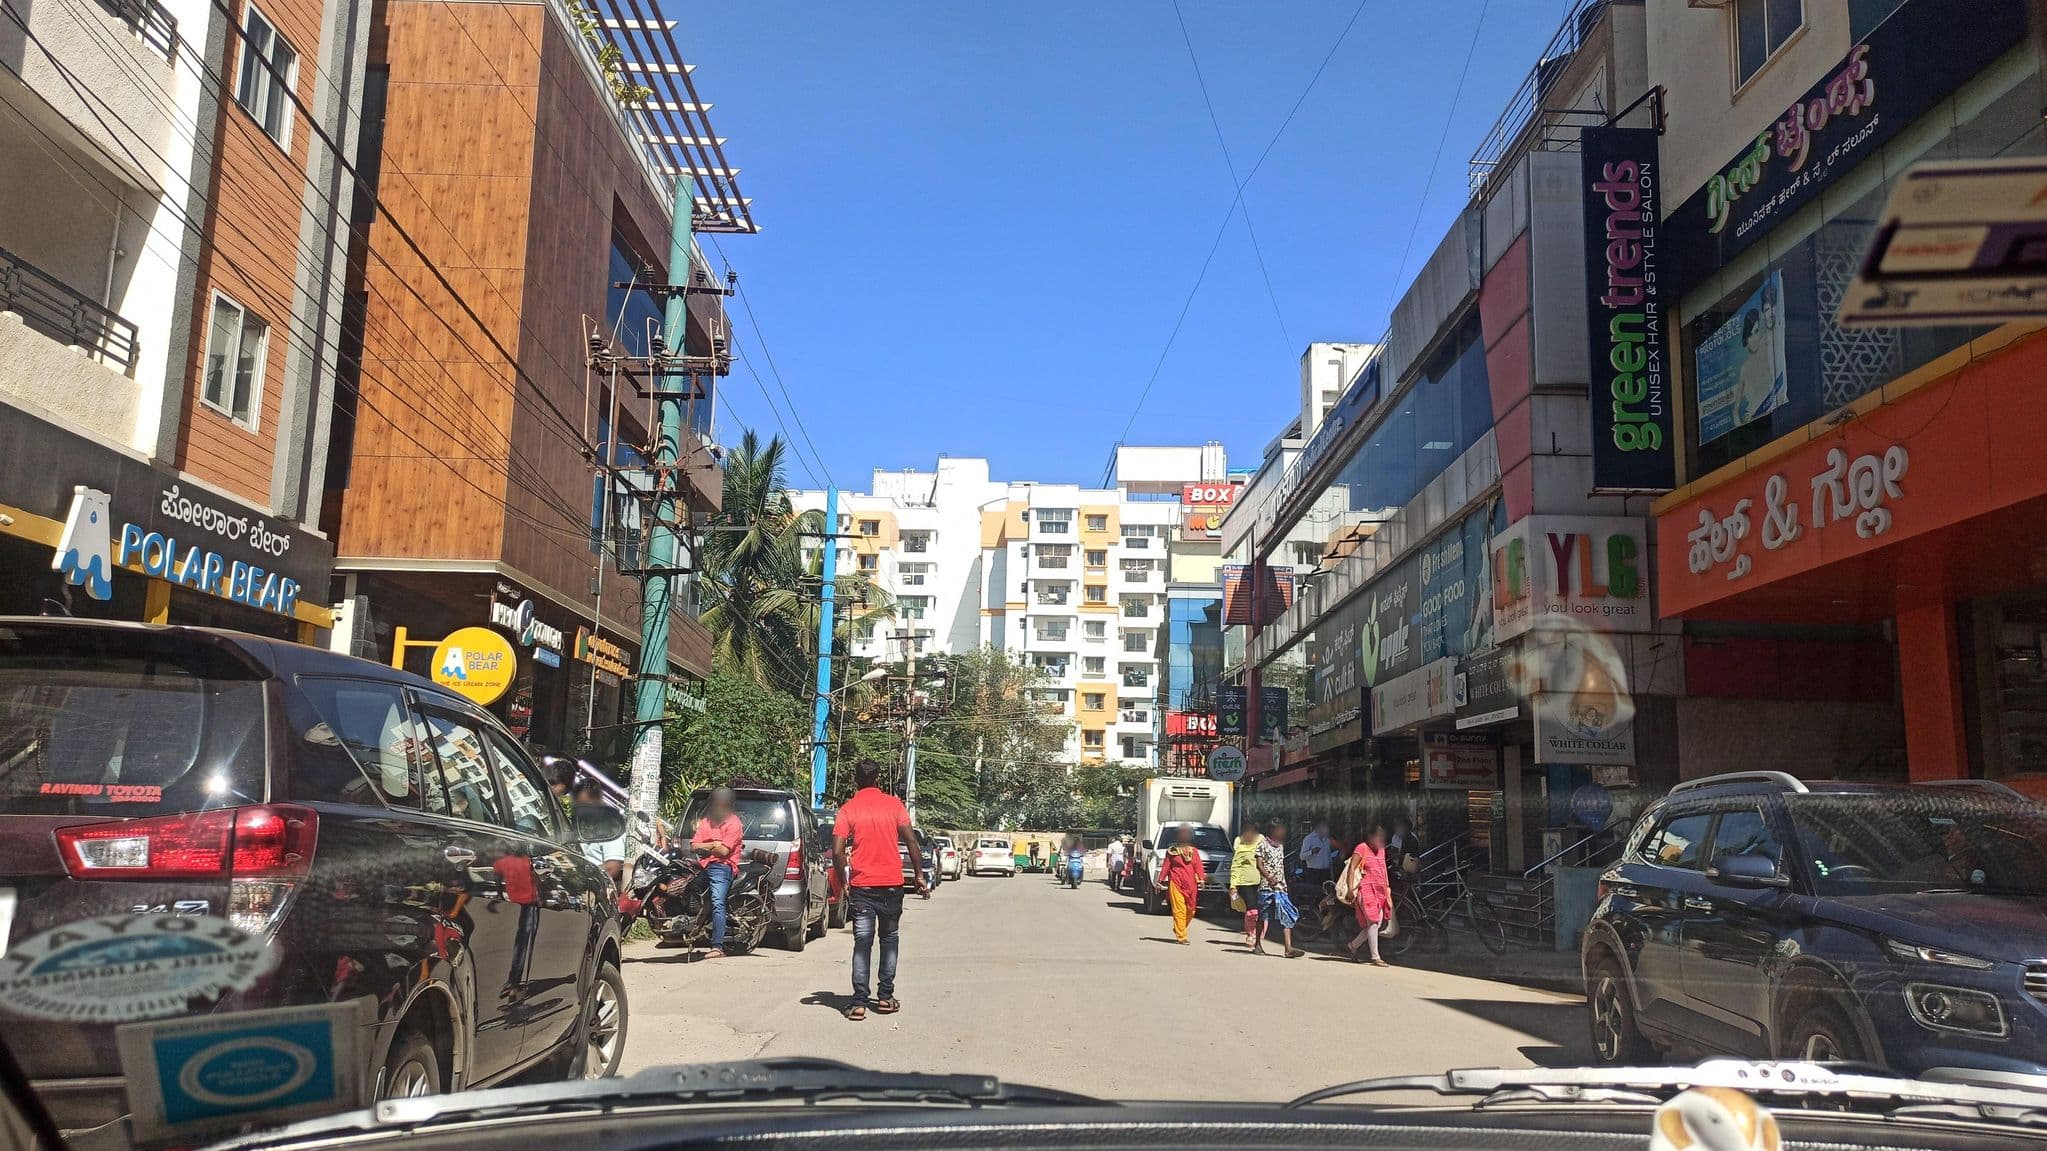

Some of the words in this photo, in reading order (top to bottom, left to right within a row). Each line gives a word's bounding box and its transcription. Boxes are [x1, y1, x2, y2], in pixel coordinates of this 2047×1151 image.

[1639, 162, 1653, 223] SALON
[1642, 230, 1657, 283] STYLE
[1645, 302, 1659, 346] HAIR
[1649, 349, 1662, 416] UNISEX
[161, 484, 249, 540] ಪೋಲಾರ್
[249, 519, 291, 557] ಬೇರ್
[1762, 475, 1802, 550] &
[119, 522, 224, 597] POLAR
[229, 560, 301, 617] BEAR
[1545, 533, 1638, 598] YLG
[1423, 592, 1442, 619] GOOD
[1443, 579, 1466, 605] FOOD
[1543, 603, 1568, 616] you
[1571, 602, 1599, 615] look
[1602, 603, 1636, 617] great
[465, 651, 503, 661] POLAR
[468, 661, 498, 671] BEAR
[1548, 739, 1585, 749] WHITE
[1586, 740, 1626, 750] COLLAR
[40, 783, 104, 796] RAVINDU
[106, 784, 162, 797] TOYOTA
